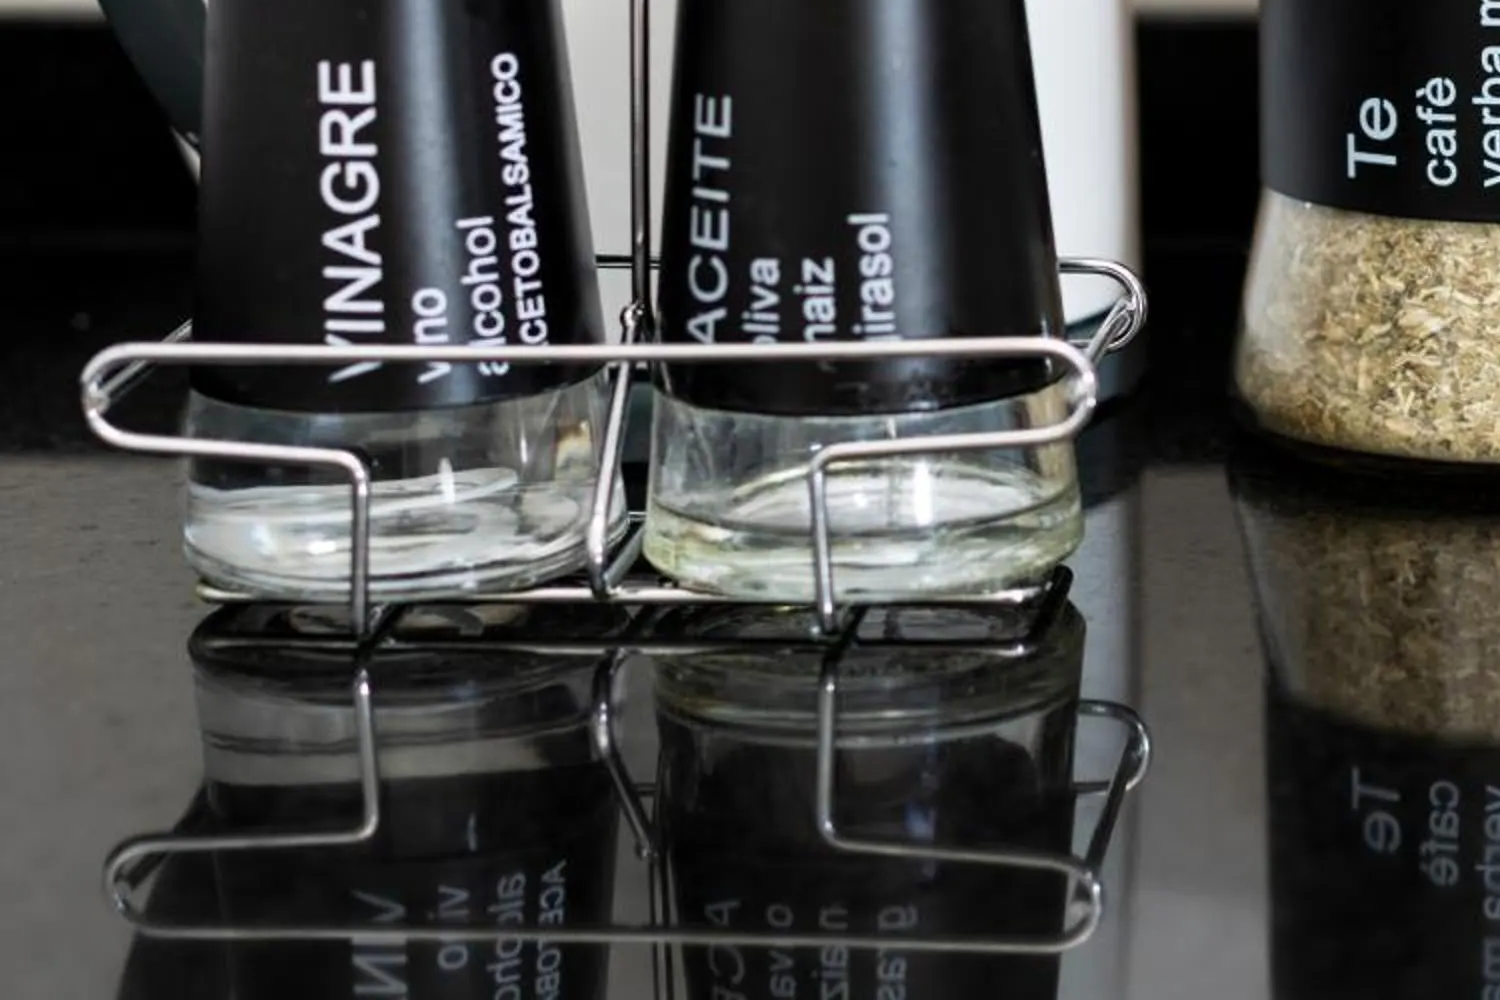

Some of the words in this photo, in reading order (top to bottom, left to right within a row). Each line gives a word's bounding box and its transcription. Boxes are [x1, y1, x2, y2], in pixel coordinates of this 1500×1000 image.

[491, 52, 548, 346] CETOBALSAMICO
[1347, 97, 1397, 178] Te
[687, 94, 732, 344] ACEITE
[849, 213, 898, 341] irasol
[412, 287, 452, 383] vno
